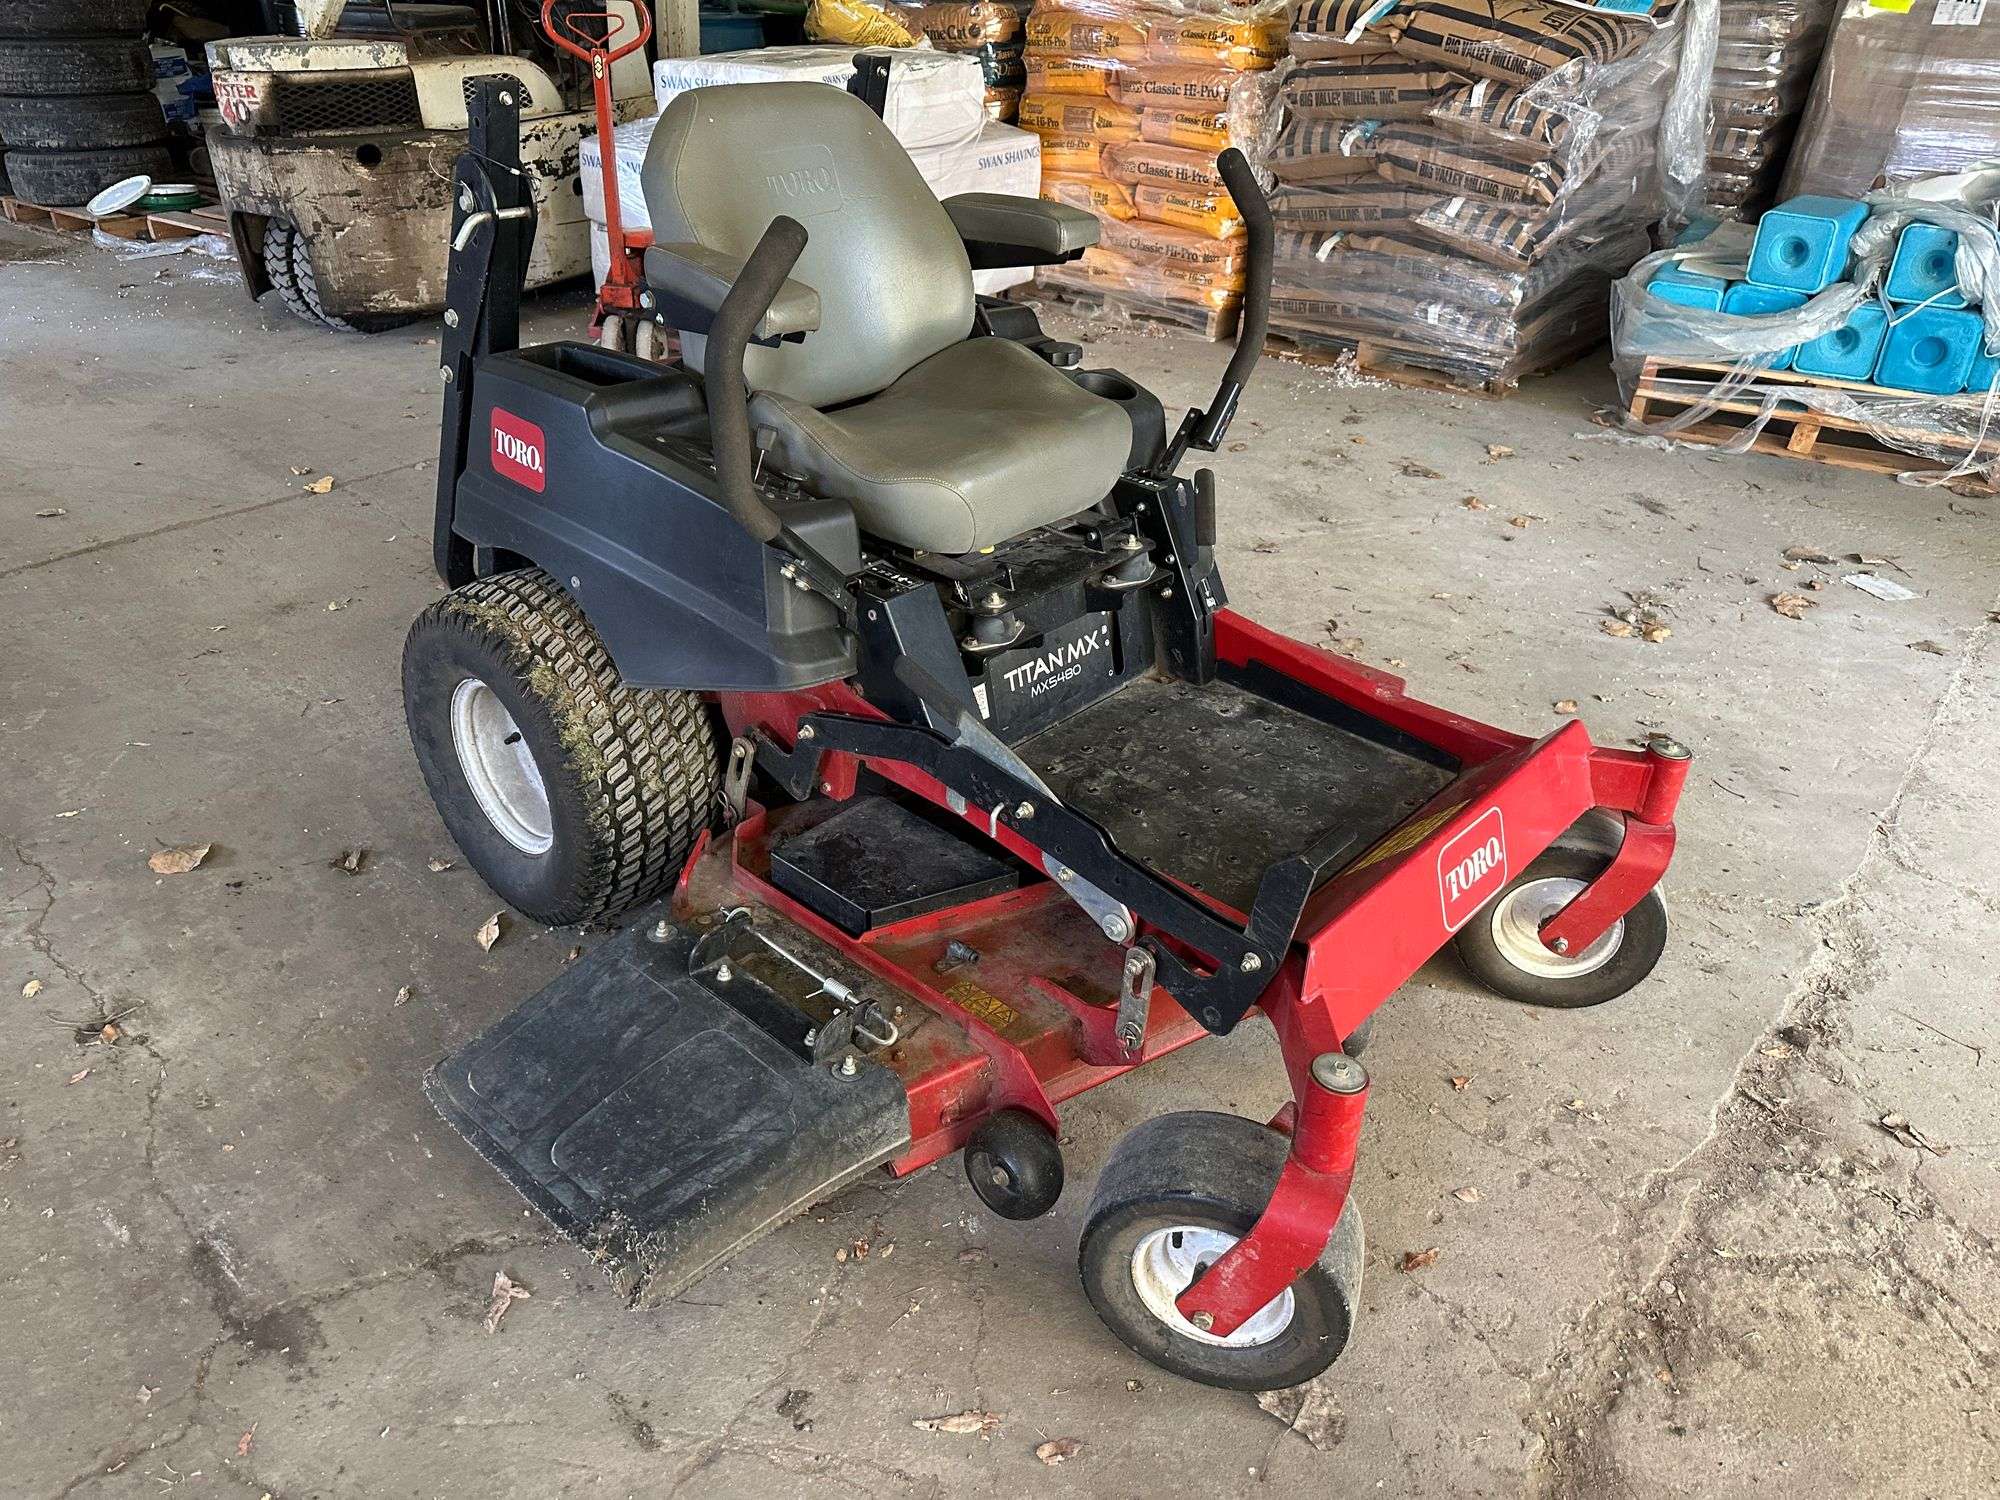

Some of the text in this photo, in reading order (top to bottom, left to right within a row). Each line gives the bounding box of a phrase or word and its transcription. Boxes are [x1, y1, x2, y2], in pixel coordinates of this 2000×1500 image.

[1180, 29, 1207, 40] Classic
[660, 74, 692, 90] SWAN
[1144, 81, 1181, 96] Classic
[1183, 83, 1219, 99] Hi-Pro
[1175, 113, 1201, 126] Classic
[582, 152, 603, 169] SWA
[978, 154, 1004, 170] SWAN
[1137, 162, 1173, 179] Classic
[1129, 238, 1164, 255] Classic
[1165, 245, 1198, 260] Hi-Pro
[1031, 663, 1082, 698] MX5480
